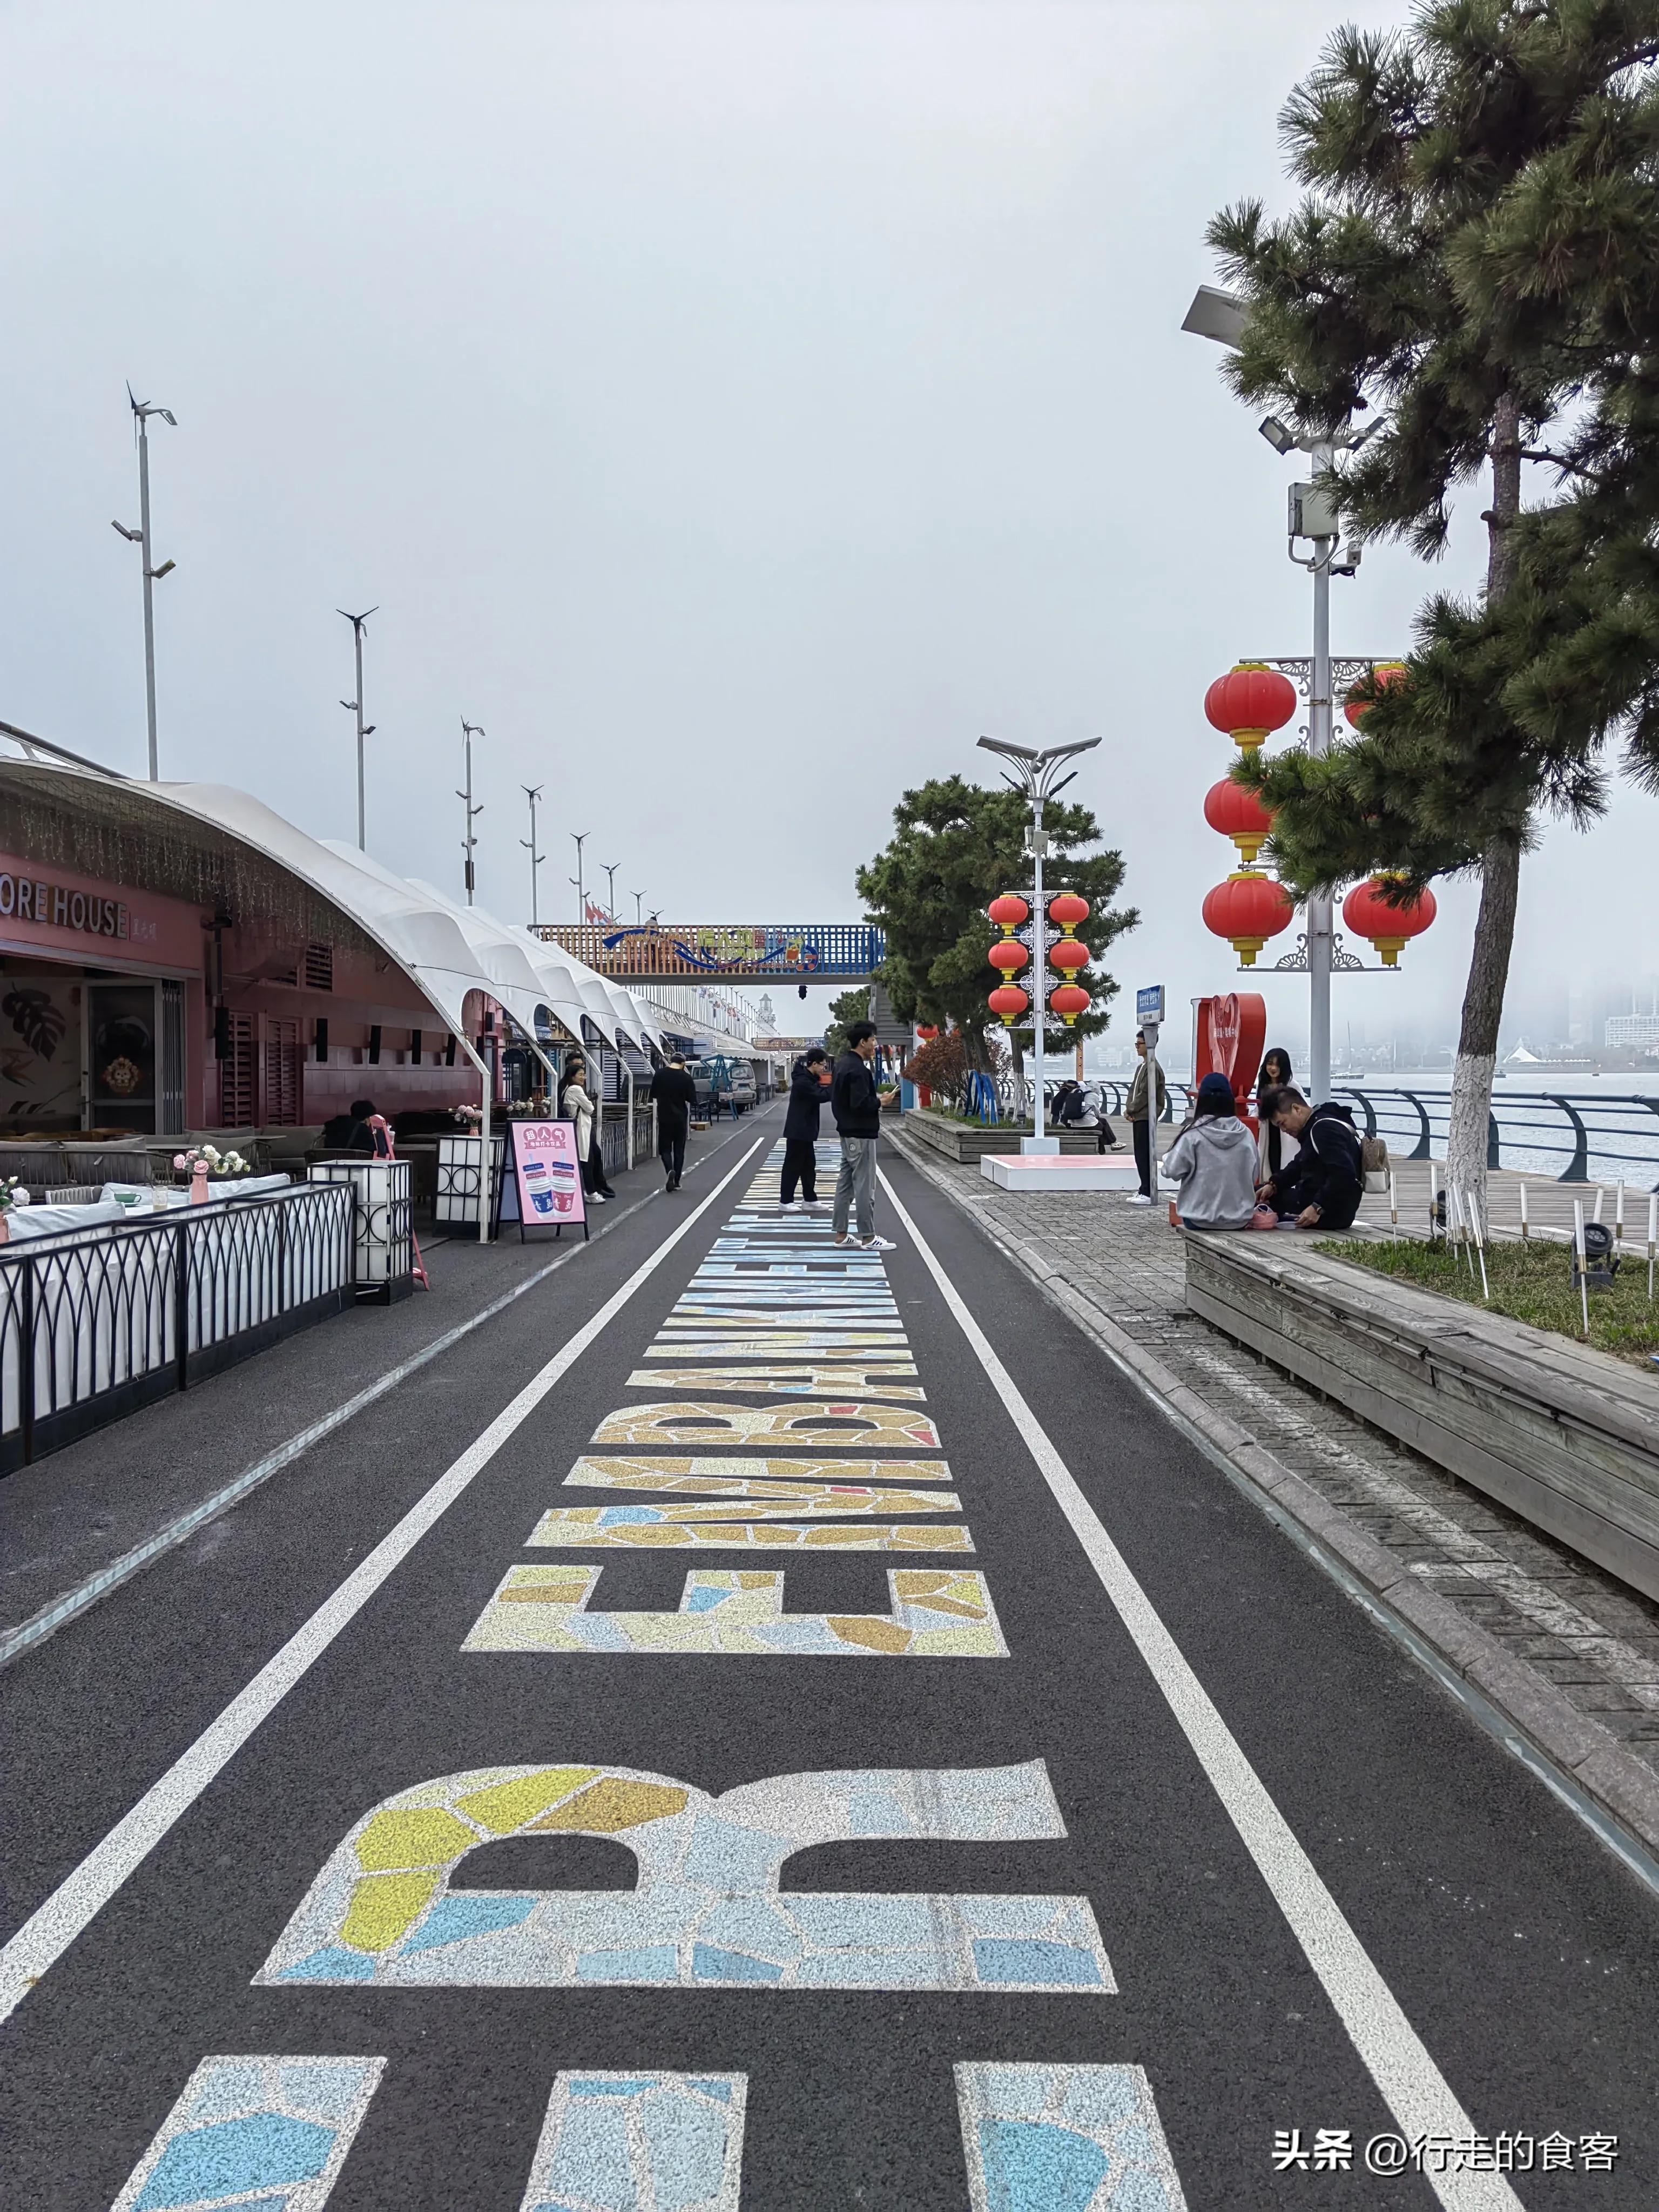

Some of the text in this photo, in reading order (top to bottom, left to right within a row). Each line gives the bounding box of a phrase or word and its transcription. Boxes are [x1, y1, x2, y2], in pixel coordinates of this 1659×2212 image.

[55, 886, 127, 940] HOUSE
[525, 1129, 563, 1140] 超人气
[459, 1237, 1011, 1657] EMBANKMENT
